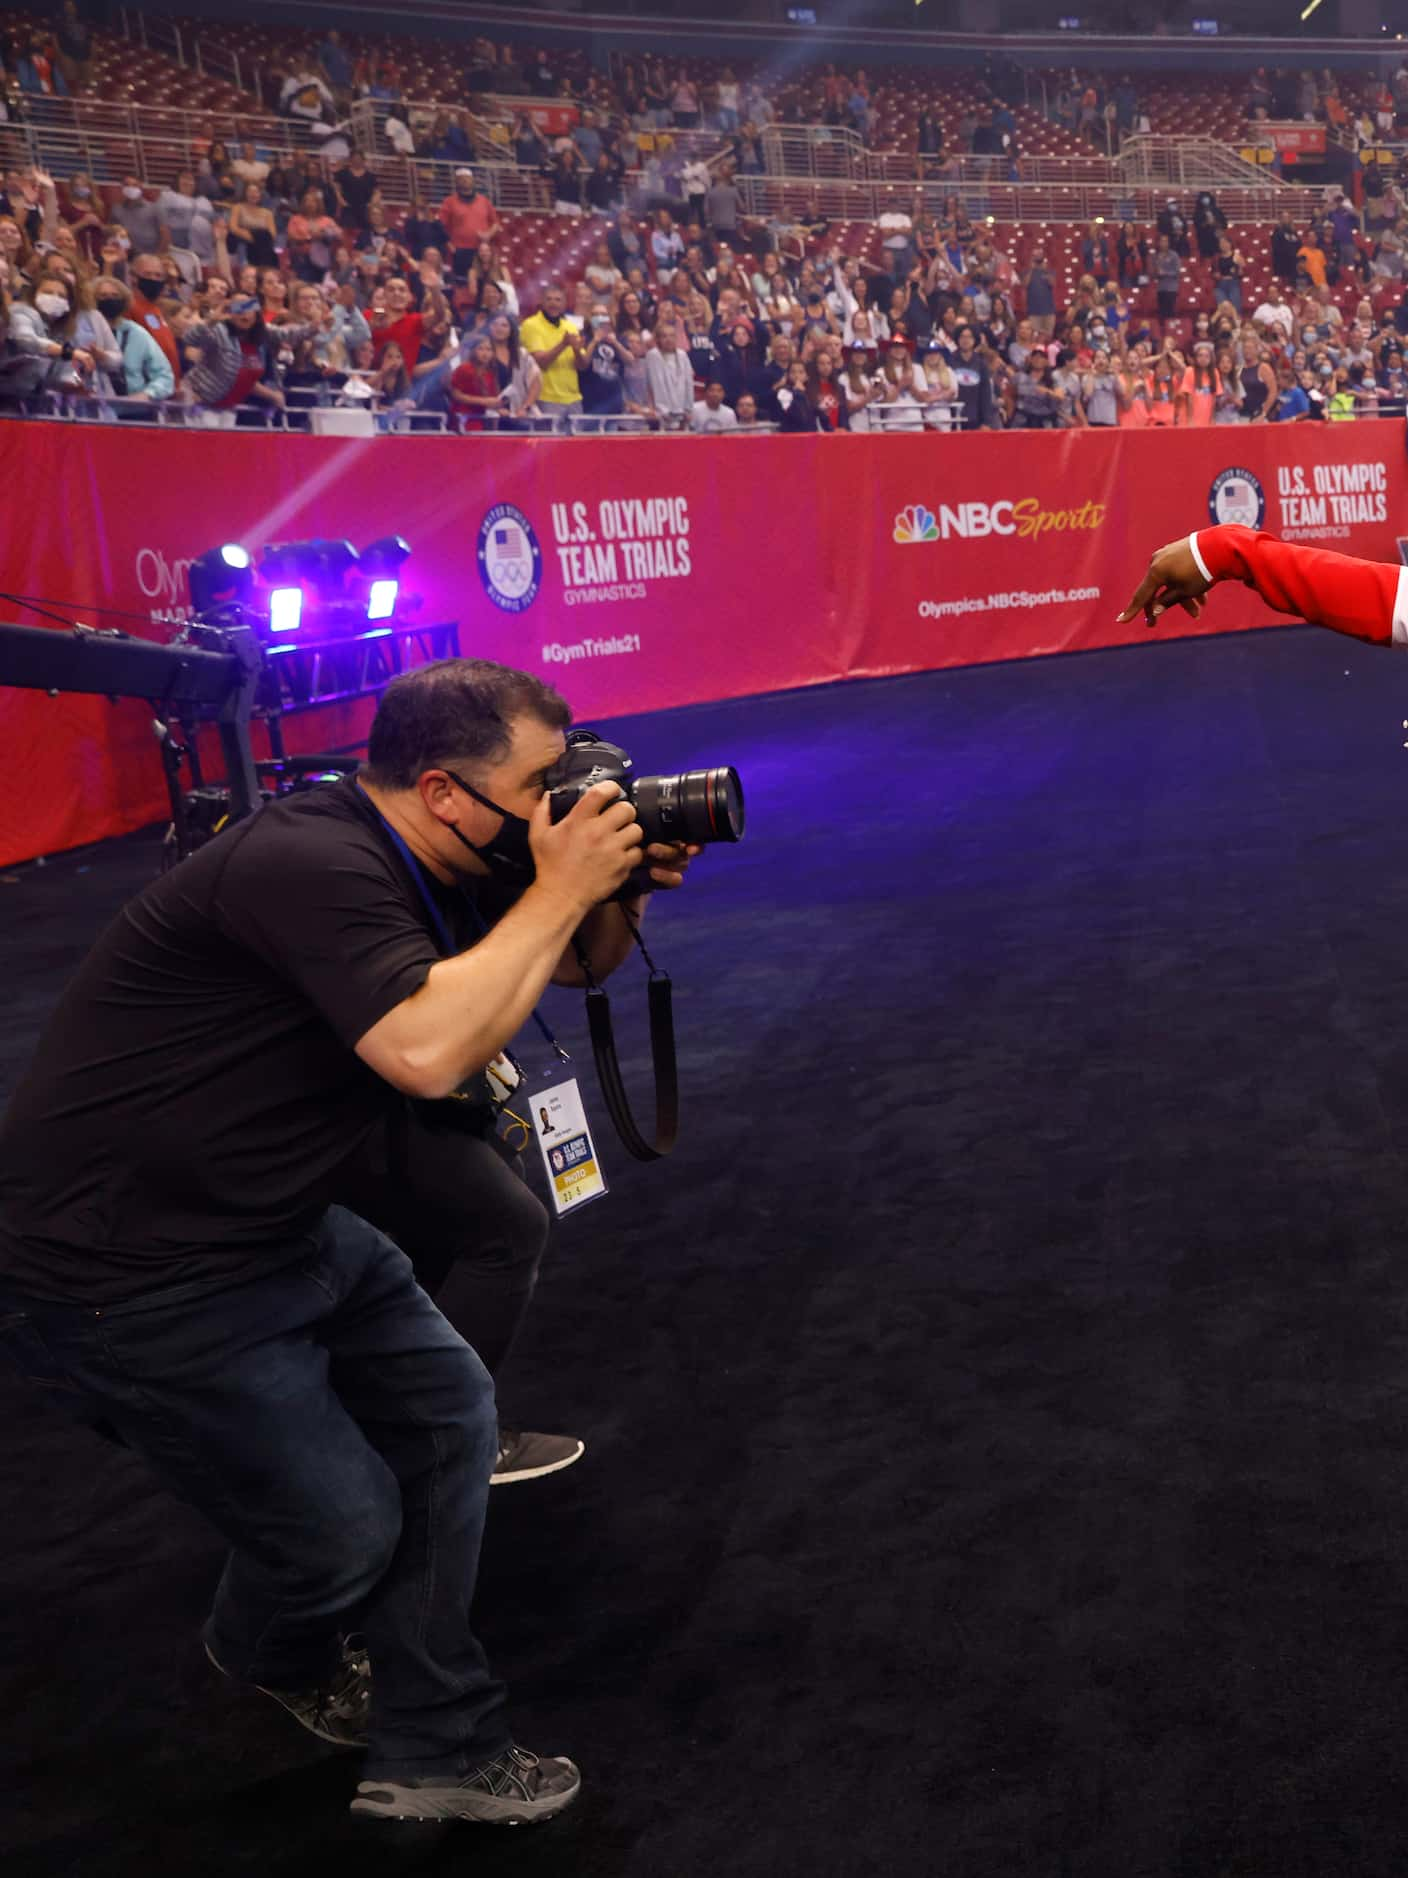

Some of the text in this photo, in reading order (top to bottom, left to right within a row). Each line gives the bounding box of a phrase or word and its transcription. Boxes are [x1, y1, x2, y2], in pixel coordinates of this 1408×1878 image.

[1278, 462, 1388, 496] U.S. OLYMPIC
[551, 496, 690, 544] U.S. OLYMPIC
[939, 498, 1105, 541] NBC Sports
[1280, 493, 1388, 527] TEAM TRIALS
[556, 538, 692, 586] TEAM TRIALS
[564, 583, 647, 605] GYMNASTICS
[918, 586, 1100, 619] Olympics.NBCSports.com
[542, 635, 640, 663] #GymTrials21
